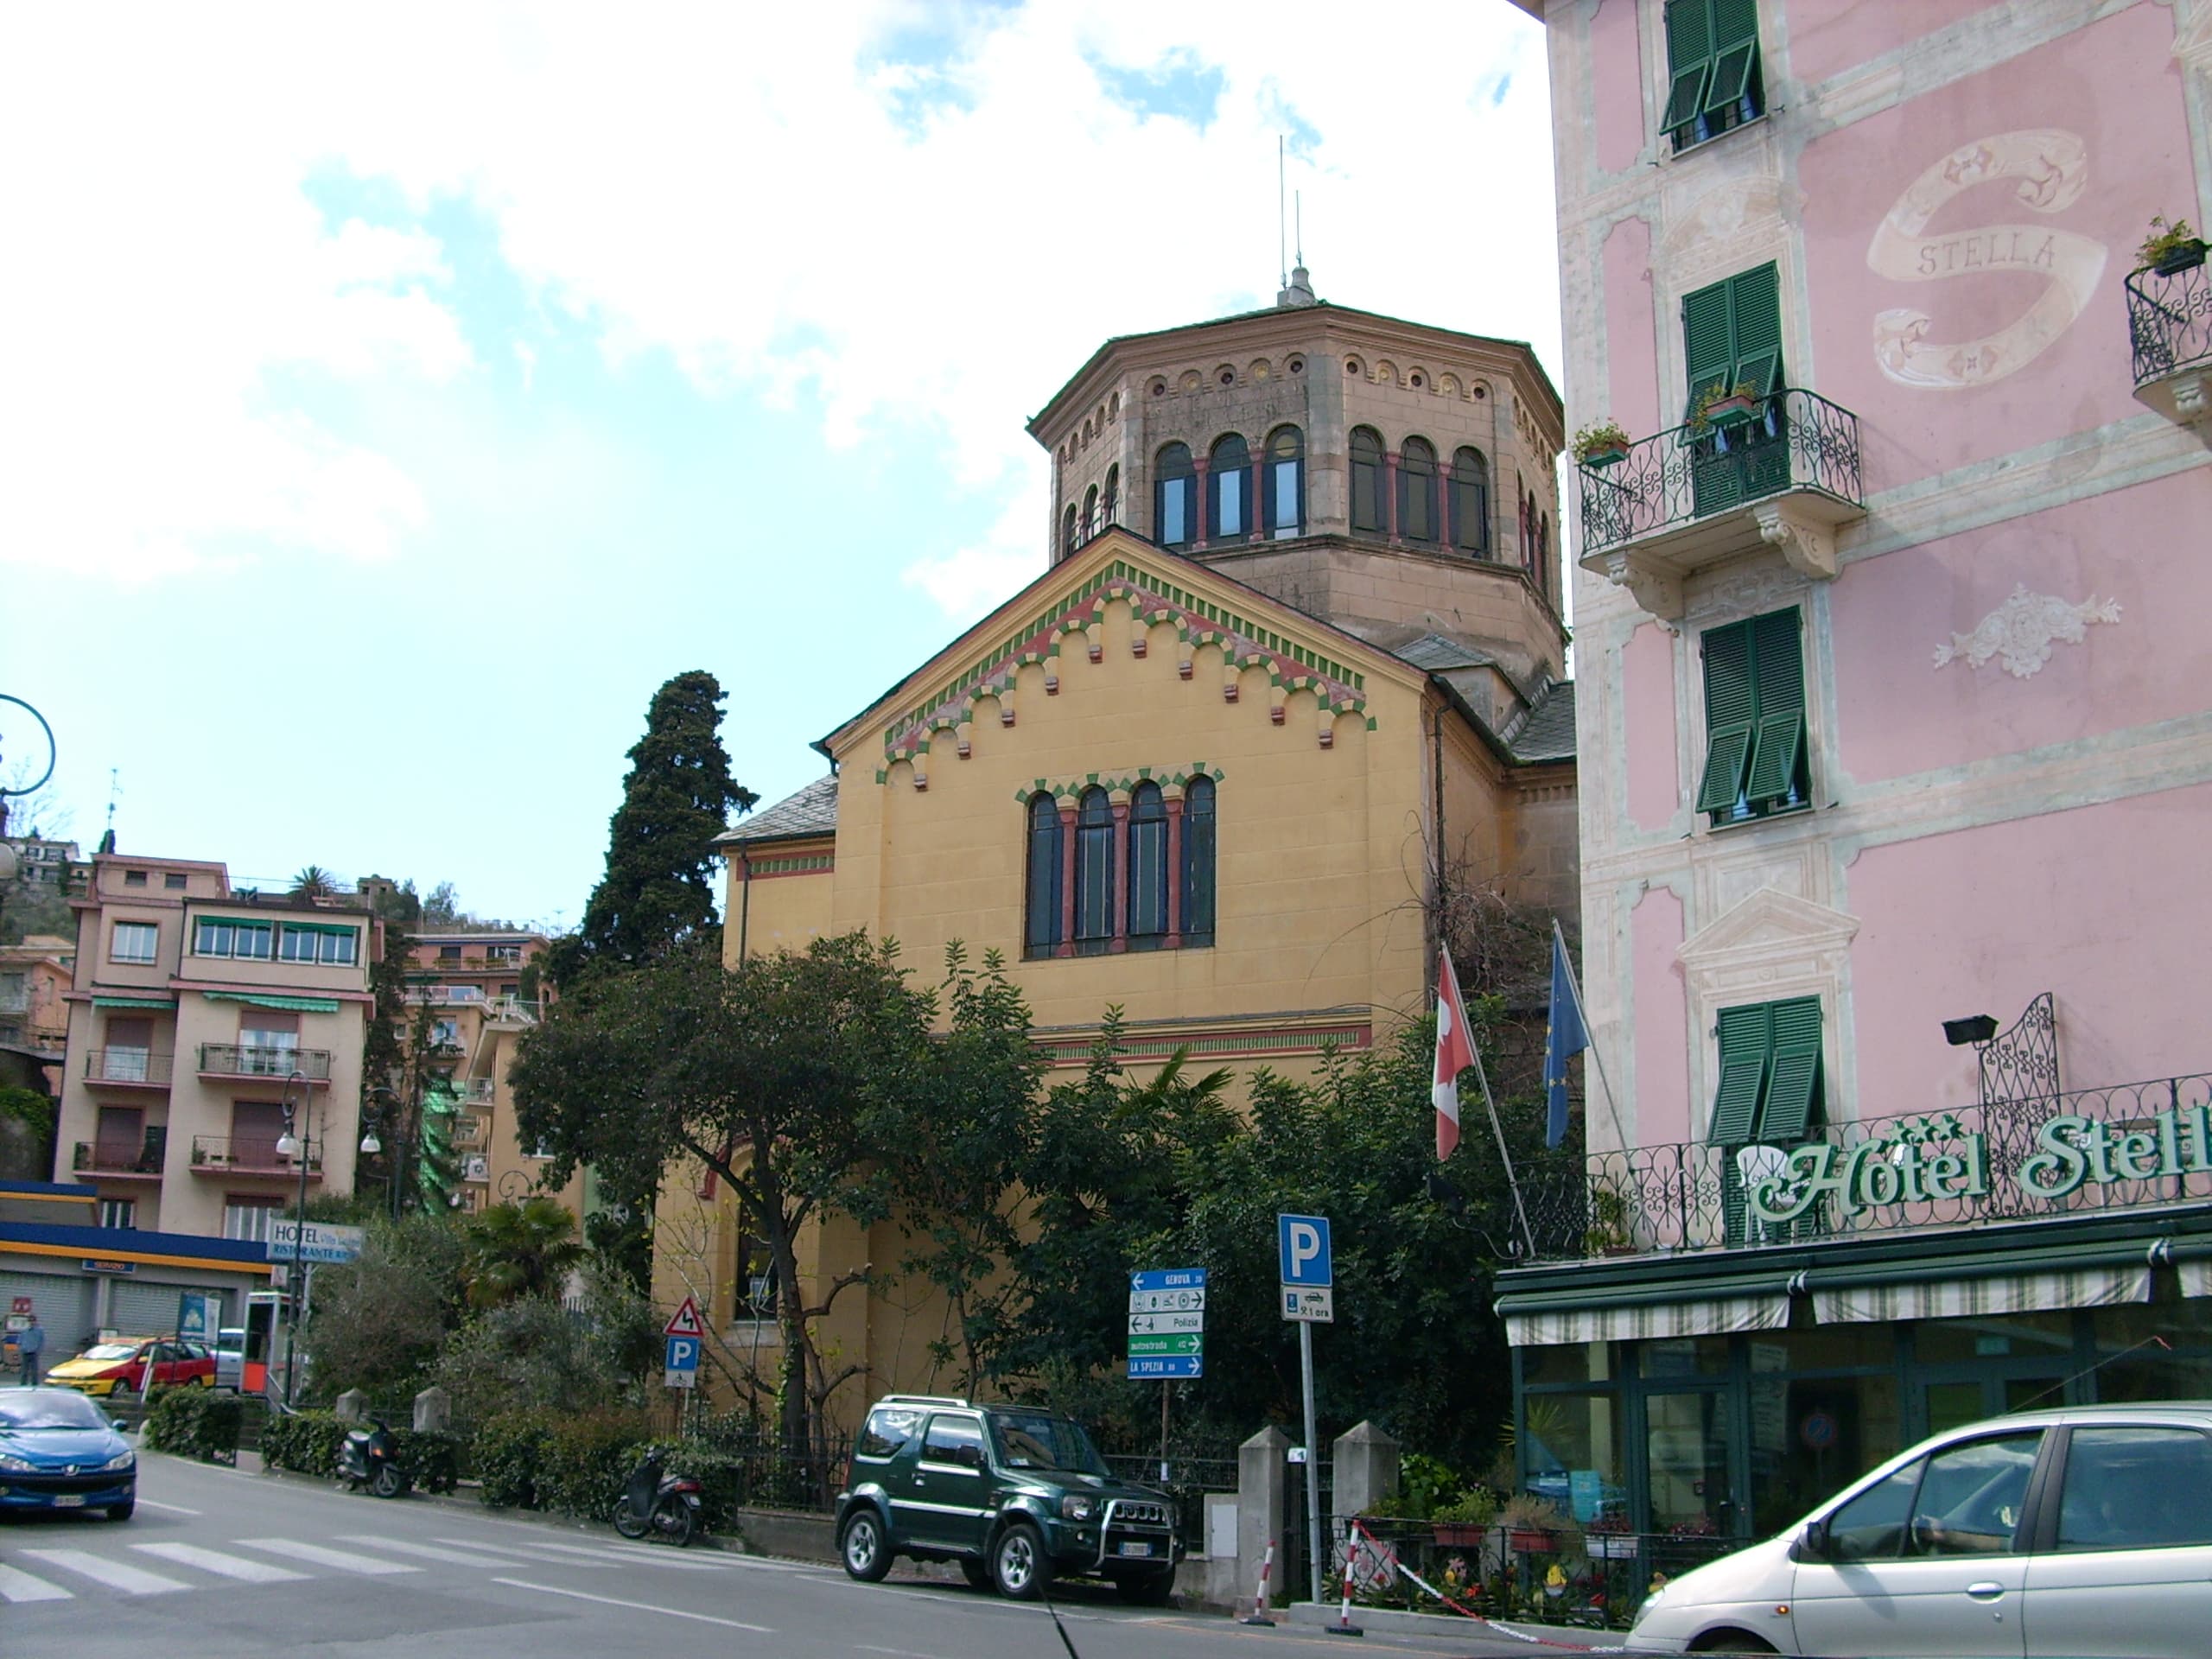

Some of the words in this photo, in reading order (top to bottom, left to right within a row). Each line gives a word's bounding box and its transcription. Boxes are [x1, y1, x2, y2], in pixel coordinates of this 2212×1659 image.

[1916, 232, 2056, 276] STELLA
[1750, 1132, 1987, 1223] Hotel
[2018, 1104, 2212, 1198] Stell
[275, 1224, 319, 1243] HOTEL
[1289, 1222, 1321, 1278] P
[1165, 1274, 1191, 1286] GENOVA
[1173, 1318, 1198, 1328] Polizia
[1315, 1309, 1330, 1318] ora
[673, 1341, 692, 1366] P
[1129, 1361, 1139, 1373] LA
[1141, 1361, 1164, 1372] SPEZIA
